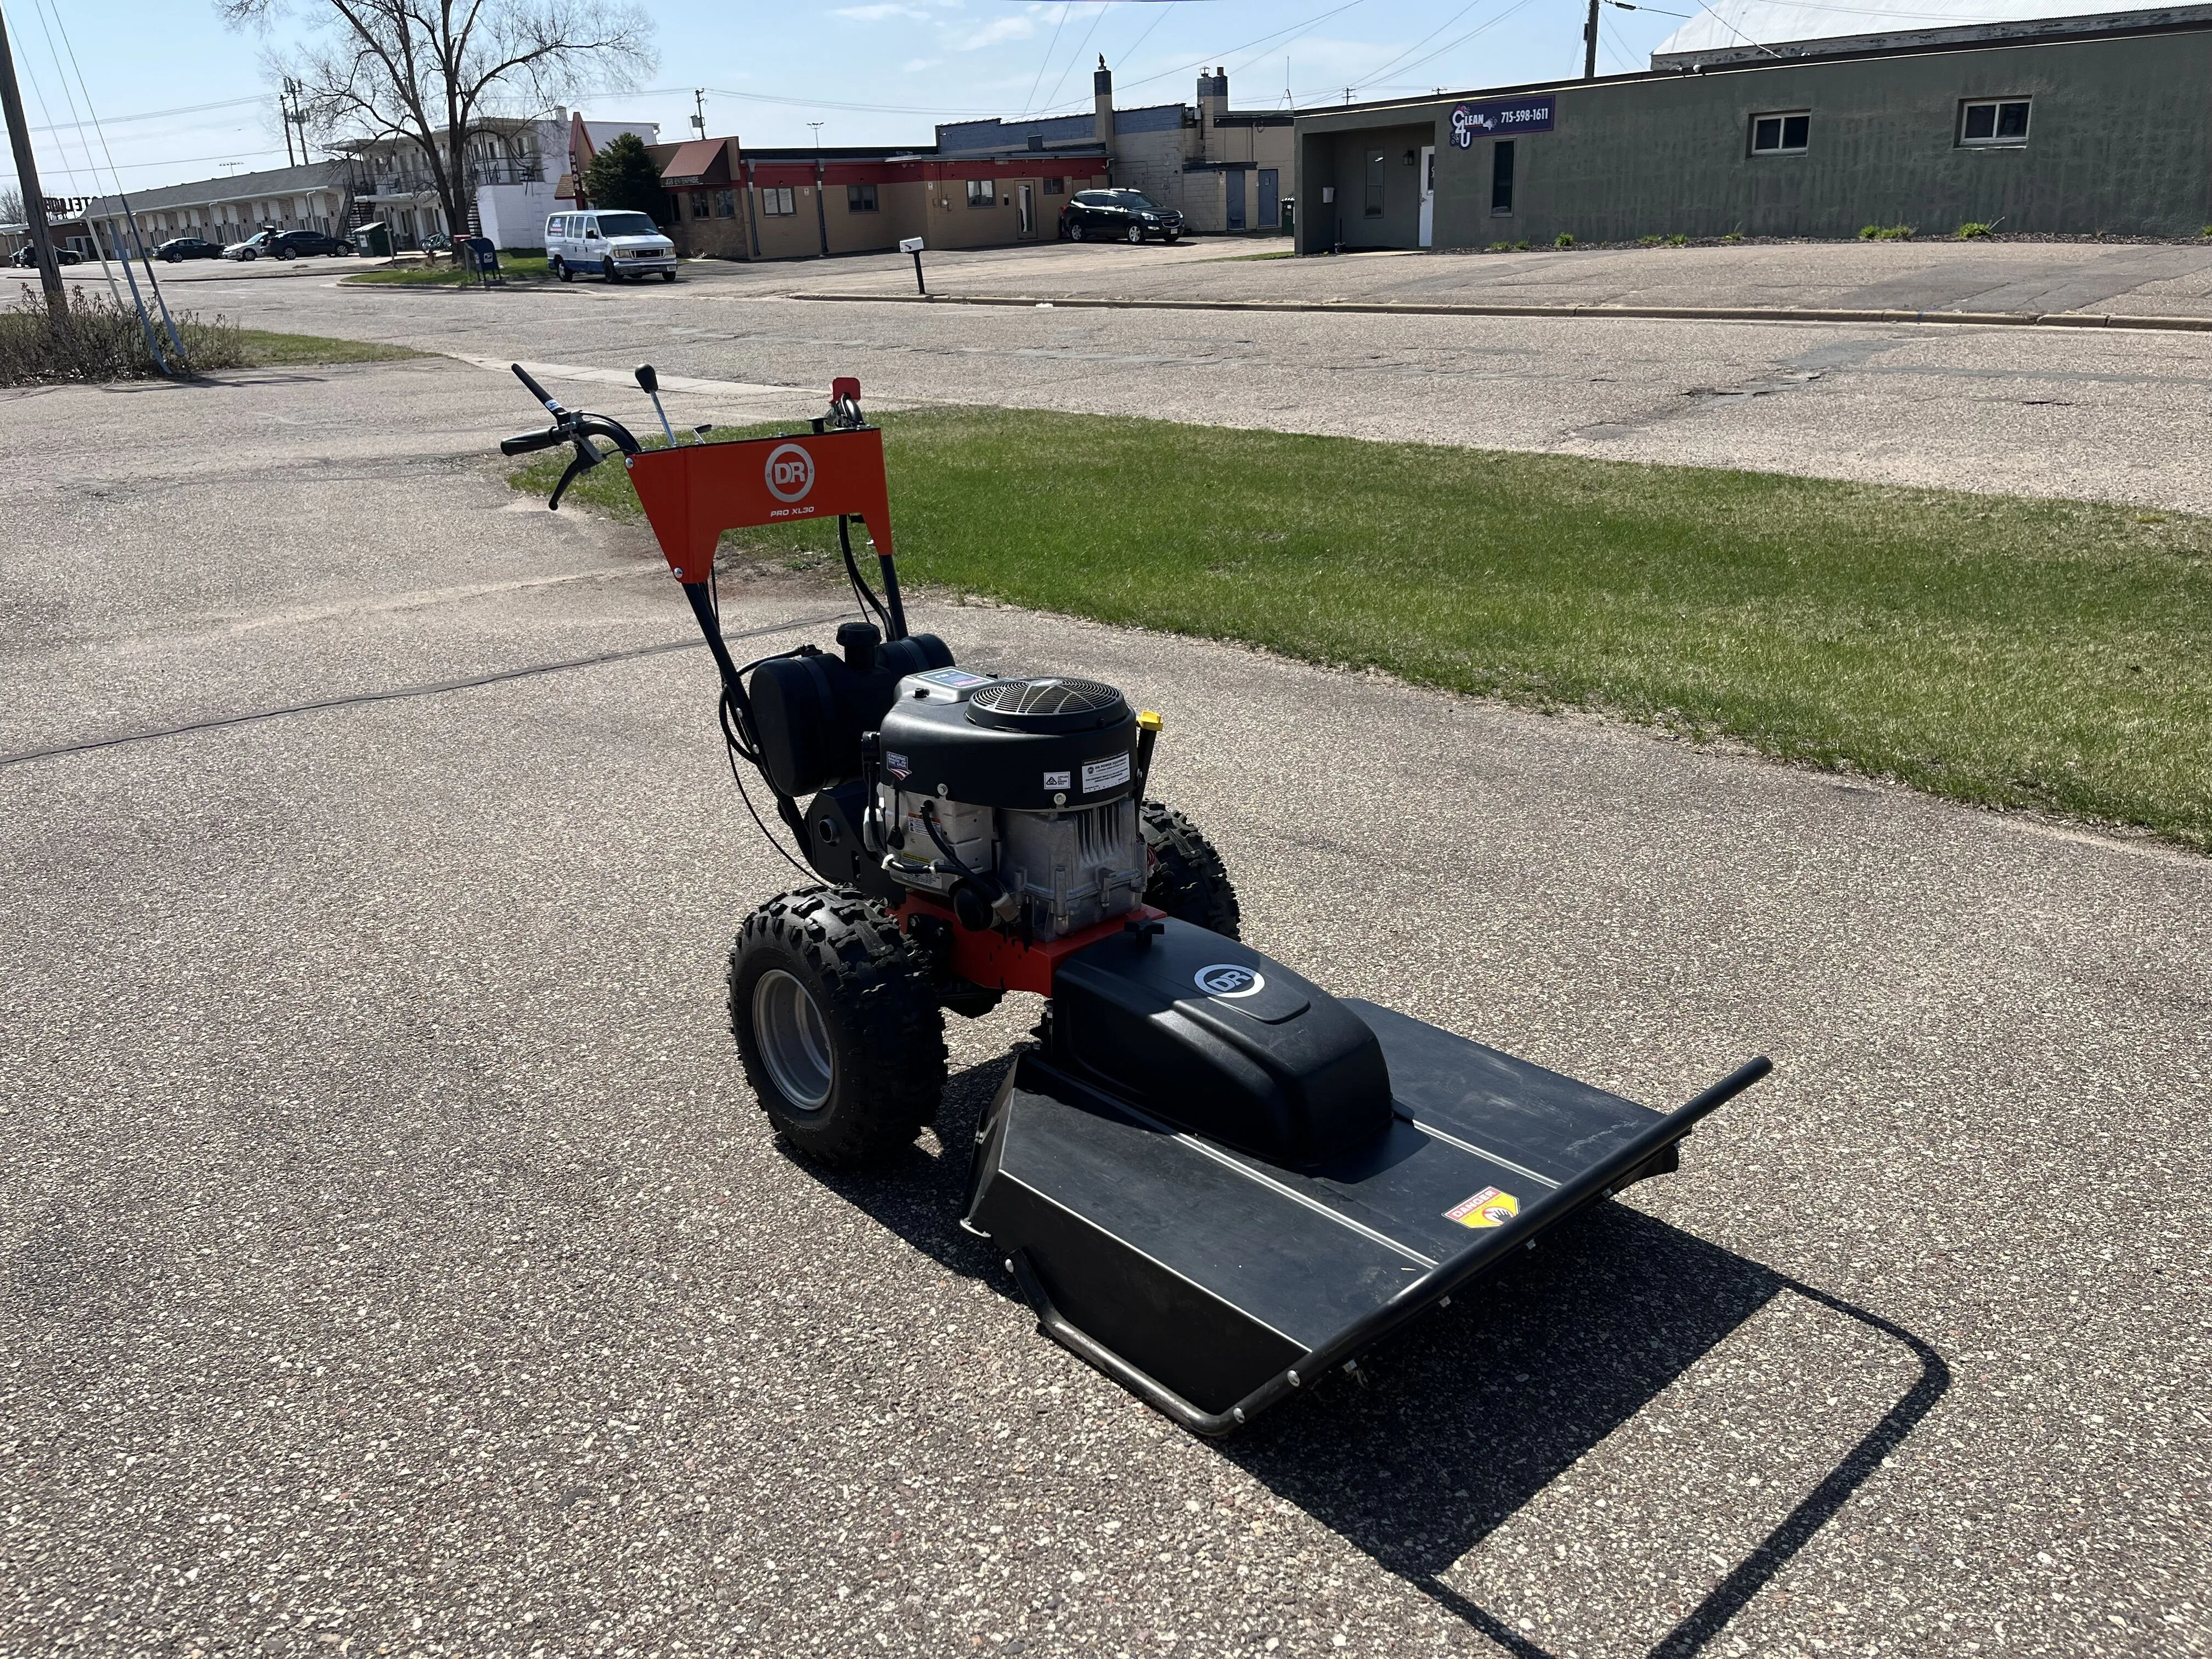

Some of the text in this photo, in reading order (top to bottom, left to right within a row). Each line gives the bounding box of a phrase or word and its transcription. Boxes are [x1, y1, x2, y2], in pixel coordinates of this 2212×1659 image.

[1453, 110, 1484, 128] CLEAN
[1501, 108, 1548, 123] 715-598-1611
[569, 155, 580, 191] 3404
[775, 462, 805, 484] DR
[792, 506, 814, 515] XL30
[1207, 970, 1251, 991] DR
[1452, 1189, 1497, 1217] DANGER
